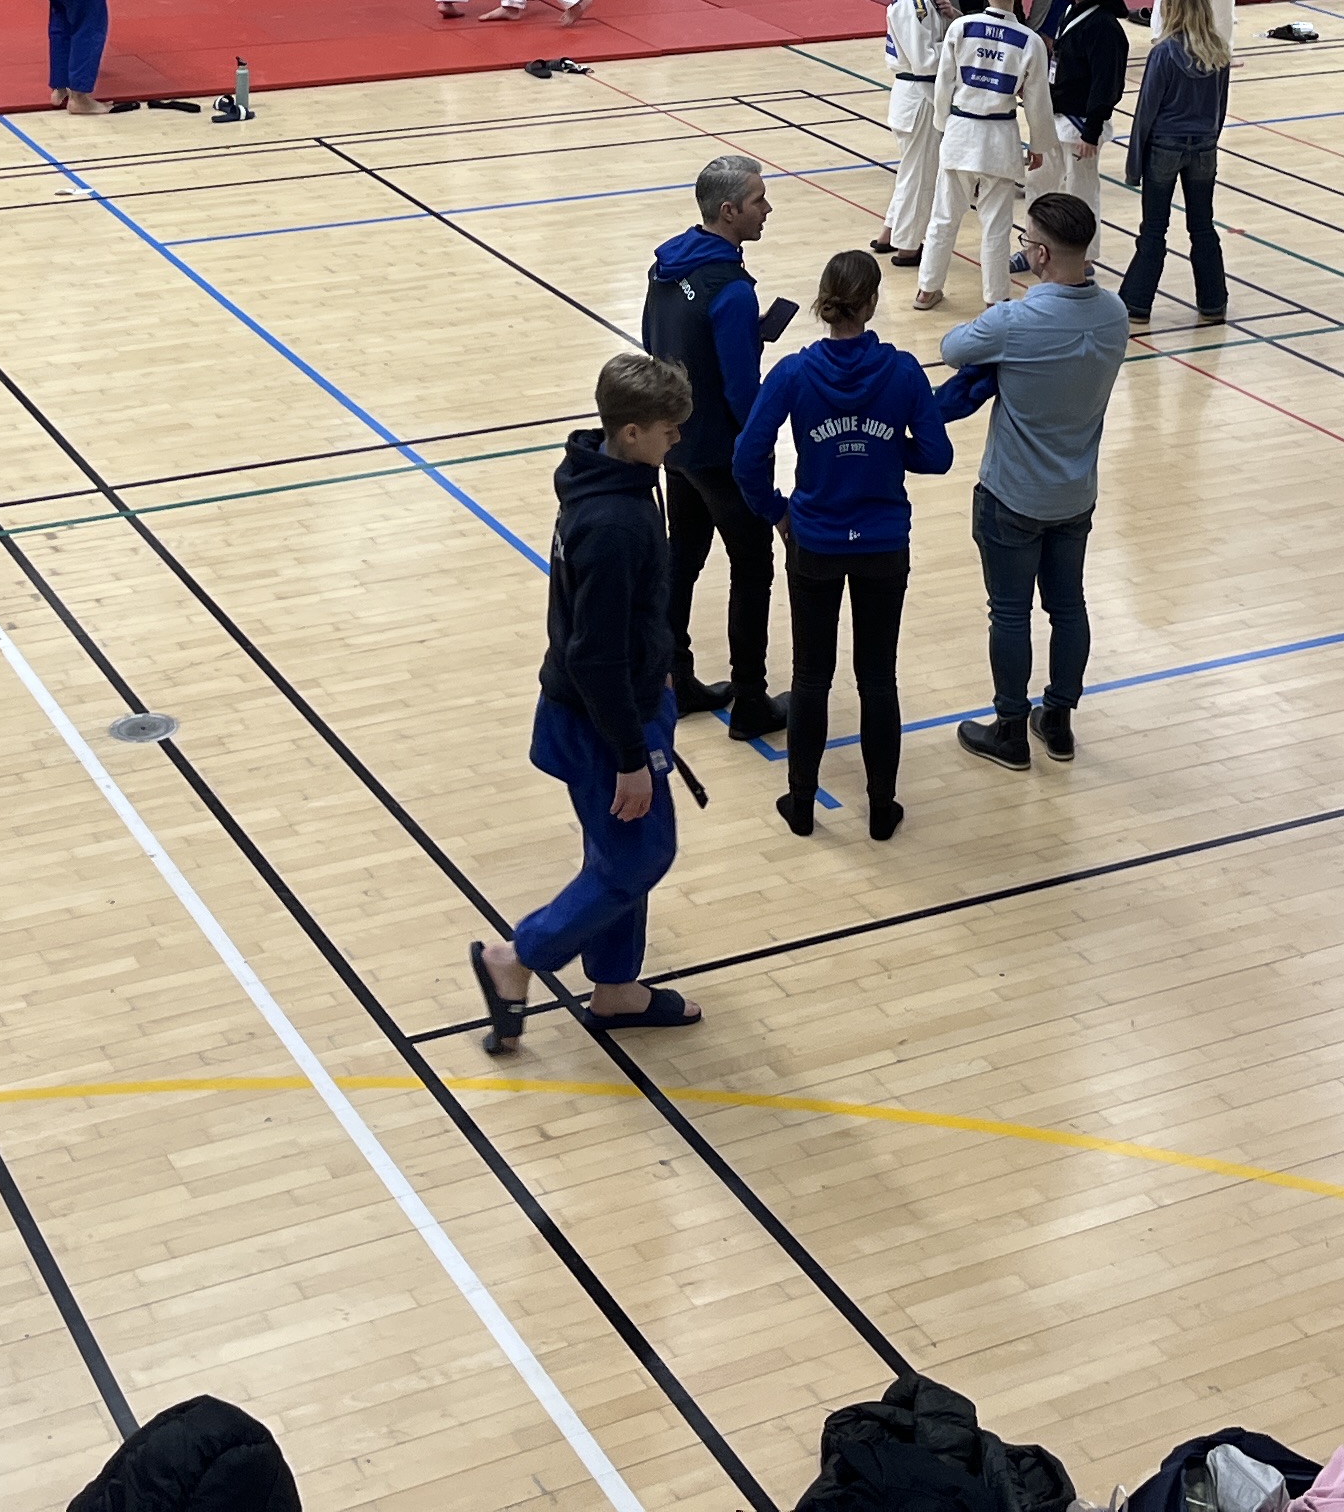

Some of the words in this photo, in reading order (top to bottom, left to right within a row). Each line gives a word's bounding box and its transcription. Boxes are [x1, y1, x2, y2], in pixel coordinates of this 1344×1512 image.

[976, 47, 1005, 62] SWE
[809, 415, 858, 443] SKÖVDE
[861, 417, 895, 441] JUDO
